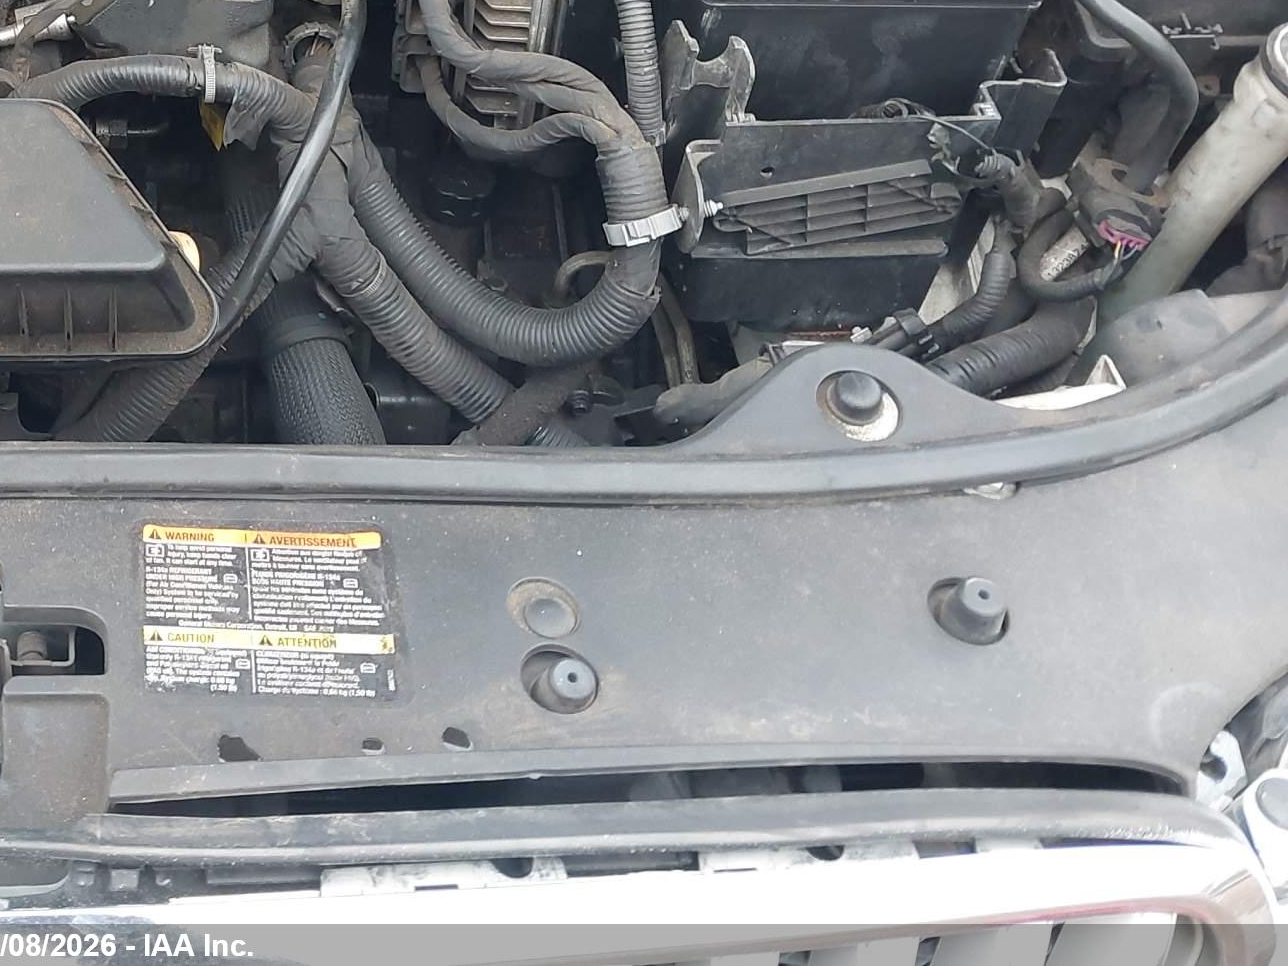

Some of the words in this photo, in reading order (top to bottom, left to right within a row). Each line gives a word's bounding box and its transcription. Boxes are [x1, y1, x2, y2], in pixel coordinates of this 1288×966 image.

[165, 532, 214, 541] WARNING
[270, 536, 356, 547] AVERTISSEMENT
[168, 633, 214, 643] CAUTION
[278, 637, 337, 648] ATTENTION
